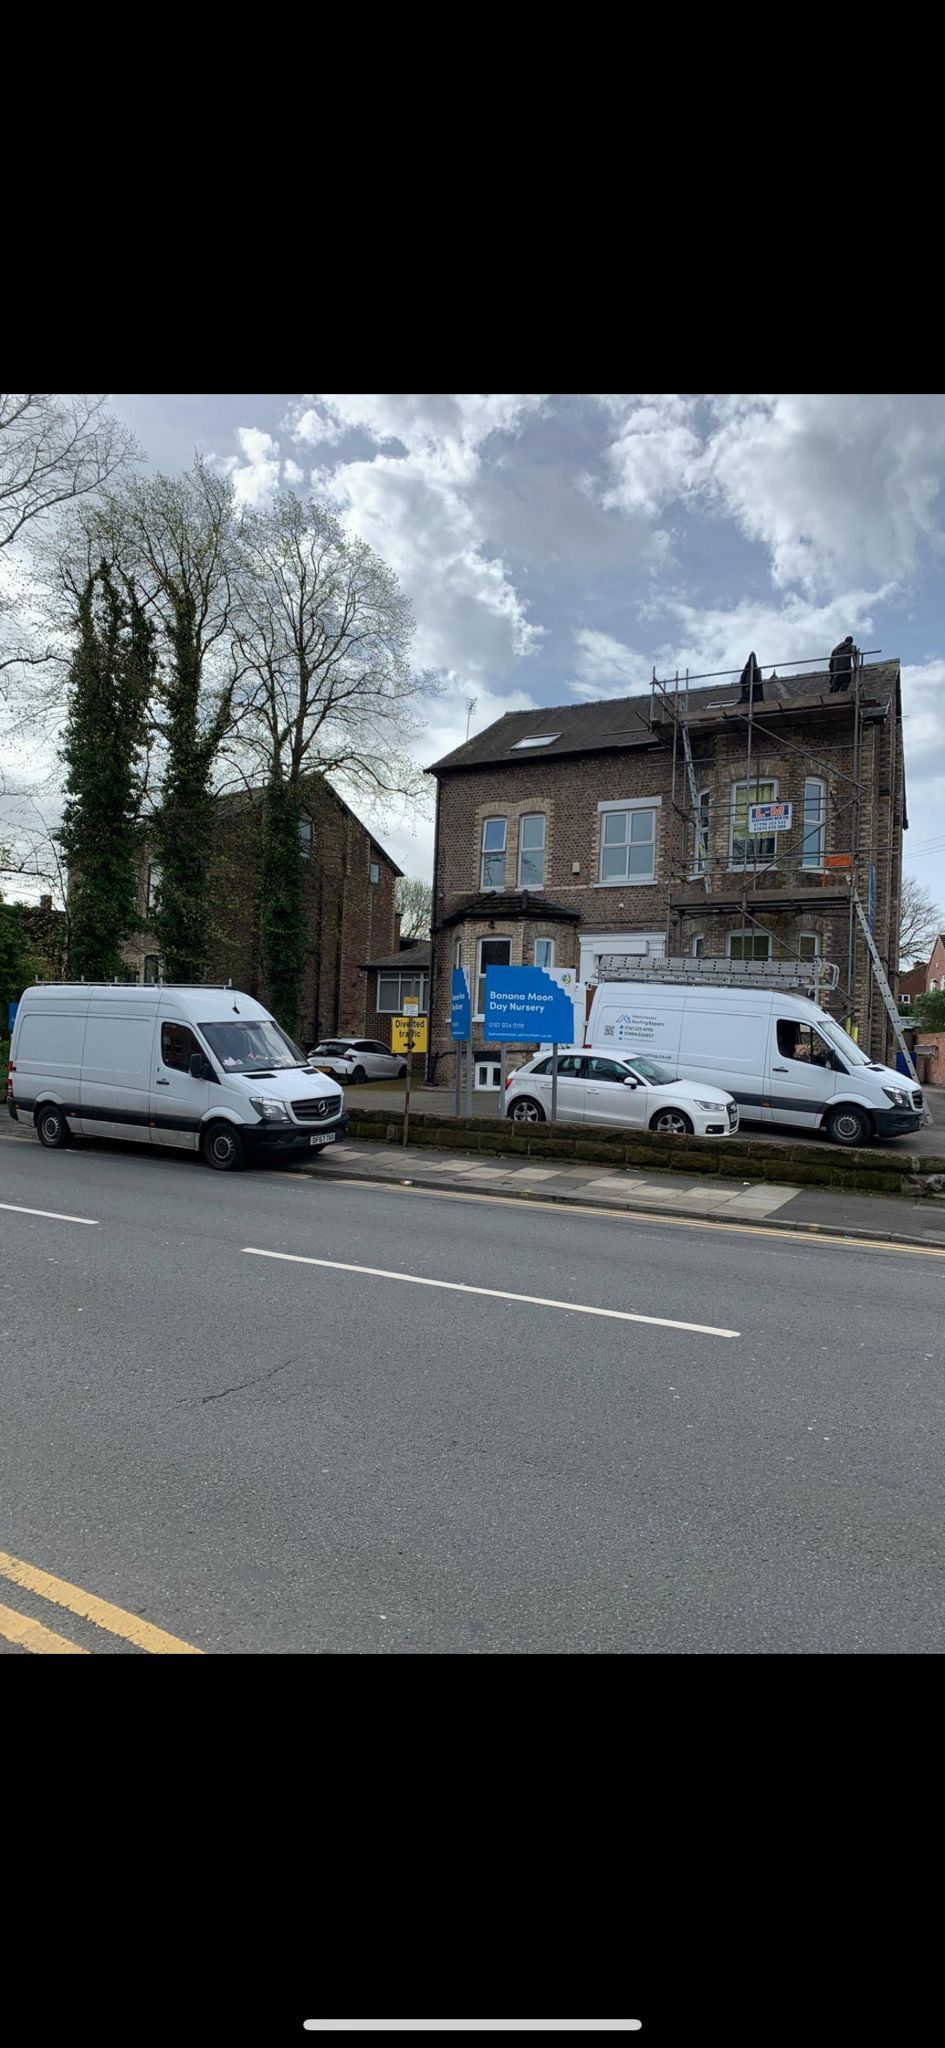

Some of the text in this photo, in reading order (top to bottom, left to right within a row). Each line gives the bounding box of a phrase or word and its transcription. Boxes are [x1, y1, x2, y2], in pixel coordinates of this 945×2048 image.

[490, 991, 553, 1001] Banana Moon
[490, 1002, 544, 1014] Day Nursery
